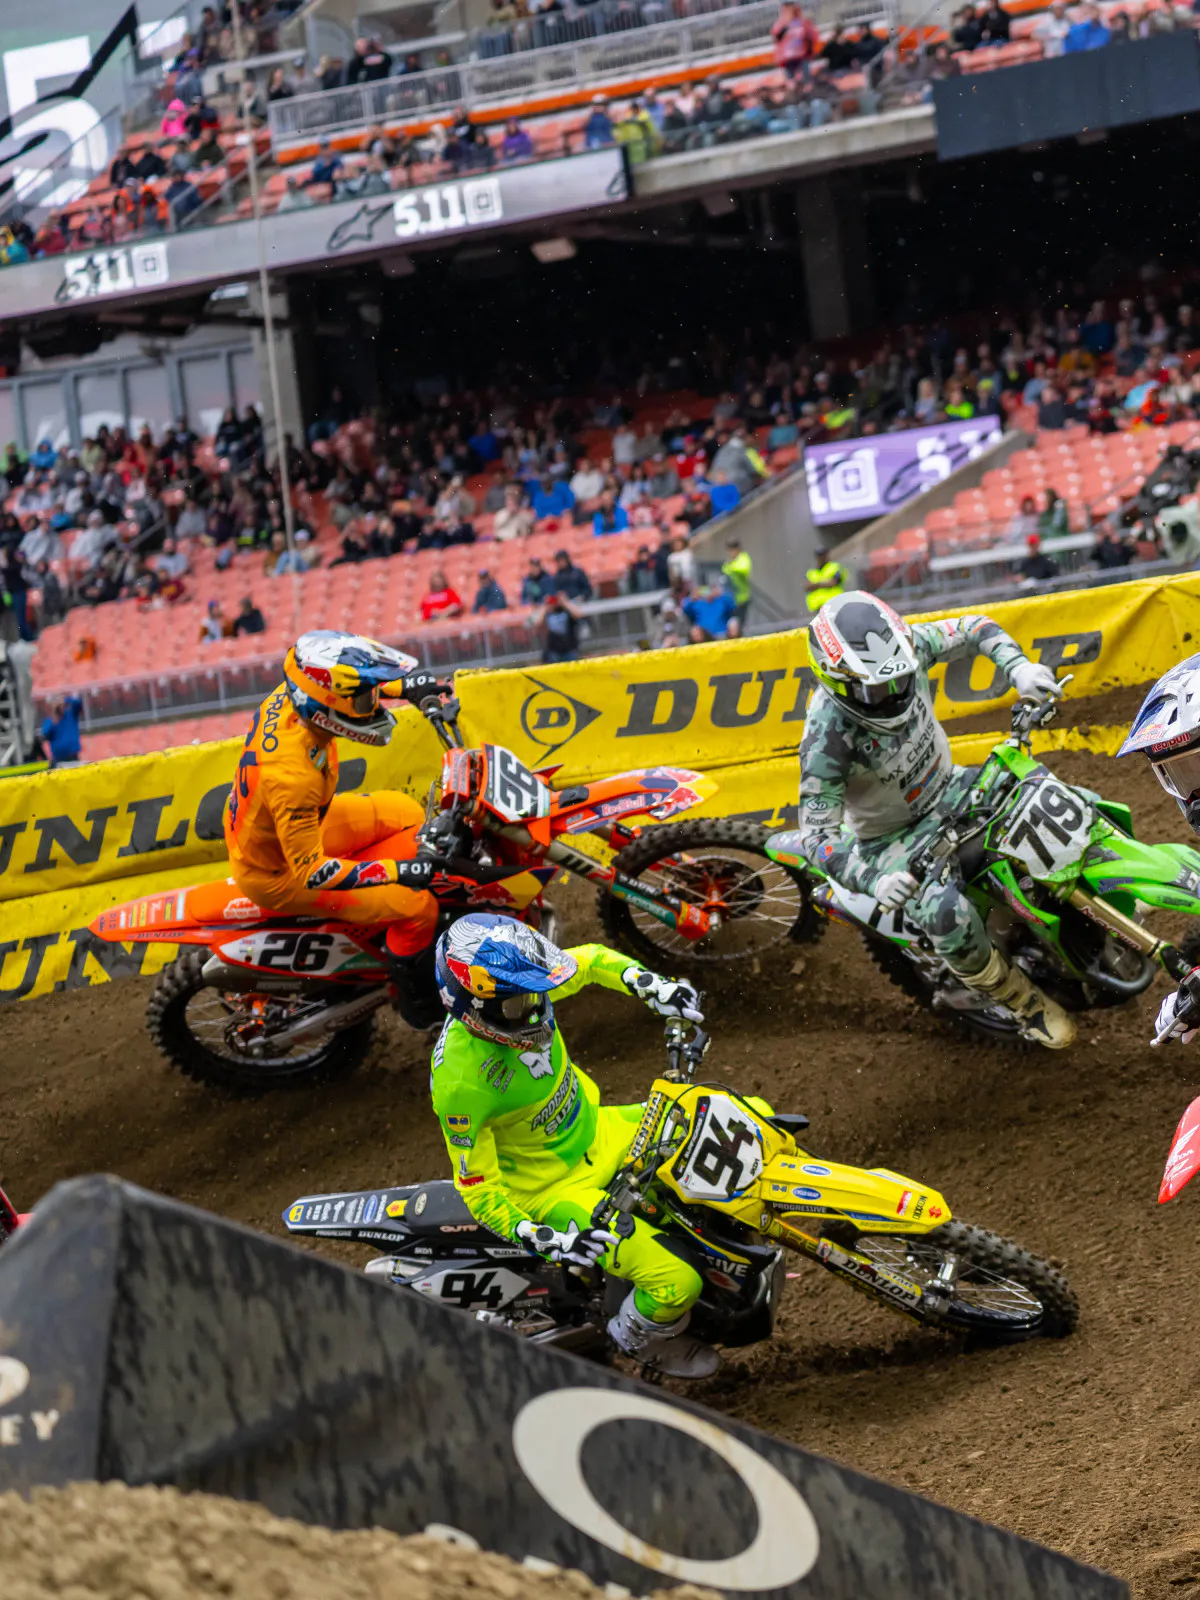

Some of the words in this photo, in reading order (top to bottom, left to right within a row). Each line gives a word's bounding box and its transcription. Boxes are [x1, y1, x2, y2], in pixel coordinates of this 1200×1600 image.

[615, 630, 1102, 738] DUOP
[1152, 740, 1171, 753] Red
[1168, 732, 1191, 748] Bull
[1009, 784, 1084, 871] 719
[399, 862, 432, 875] FOX
[258, 932, 335, 976] 26
[692, 1112, 756, 1197] 94
[772, 1202, 827, 1214] PROGRESSIVE
[358, 1230, 406, 1242] DUNLOP
[441, 1271, 503, 1309] 94
[841, 1258, 917, 1302] DUNLOP
[0, 1408, 60, 1446] EY
